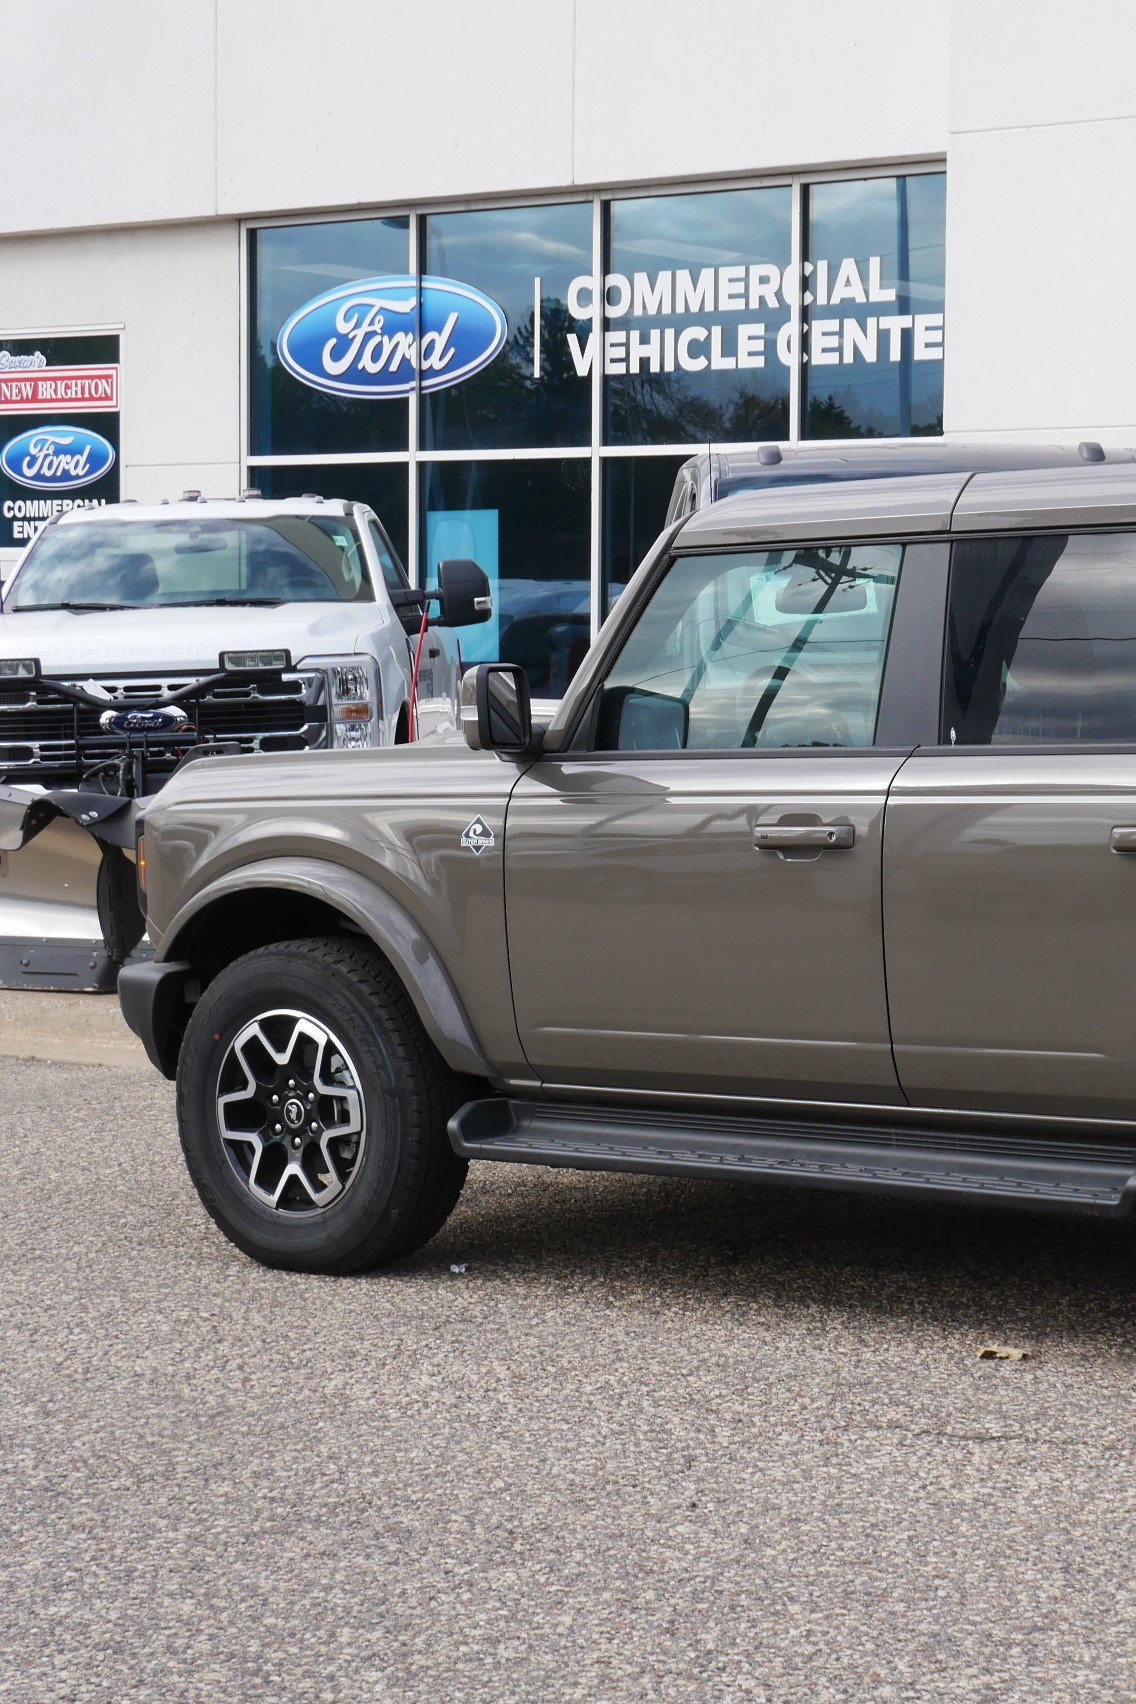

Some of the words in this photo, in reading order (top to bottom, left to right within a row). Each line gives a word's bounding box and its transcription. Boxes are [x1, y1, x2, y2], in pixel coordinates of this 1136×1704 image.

[567, 256, 897, 320] COMMERCIAL
[322, 297, 460, 376] Ford
[566, 323, 766, 377] VEHICLE
[777, 313, 944, 367] CENTE
[1, 381, 35, 401] NEW
[37, 378, 113, 400] BRIGHTON
[22, 434, 92, 478] Ford
[124, 713, 162, 728] Ford
